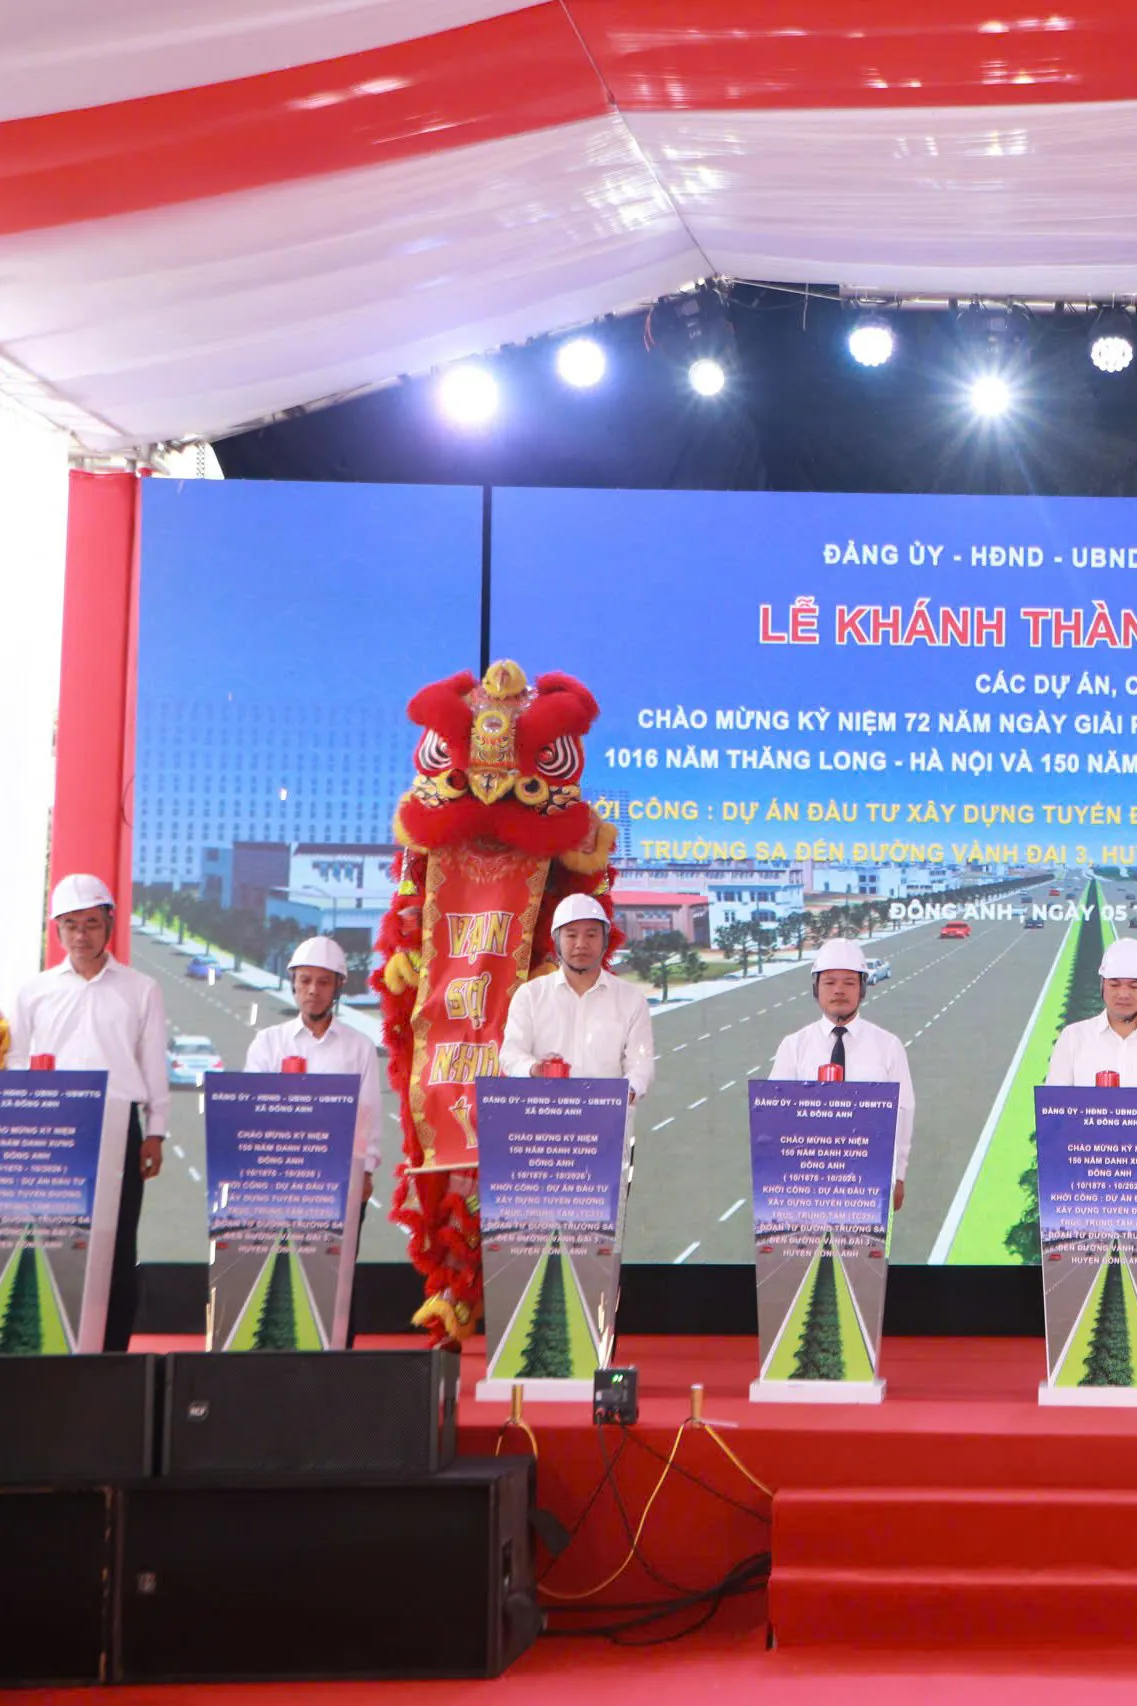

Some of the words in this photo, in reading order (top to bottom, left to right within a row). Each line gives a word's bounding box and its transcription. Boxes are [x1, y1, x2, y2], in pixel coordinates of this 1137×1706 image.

[823, 539, 899, 565] ĐẢNG
[909, 540, 944, 566] ỦY
[971, 545, 1044, 567] HĐND
[759, 595, 820, 645] LỄ
[835, 597, 1006, 647] KHÁNH
[975, 669, 1026, 694] CÁC
[1034, 674, 1071, 699] DỰ
[1076, 671, 1117, 697] ÁN,
[638, 705, 708, 729] CHÀO
[715, 706, 789, 730] MỪNG
[798, 707, 831, 731] KỶ
[838, 709, 897, 736] NIỆM
[904, 712, 930, 732] 72
[938, 709, 991, 733] NĂM
[999, 710, 1067, 734] NGÀY
[1074, 711, 1123, 734] GIẢI
[605, 748, 658, 768] 1016
[666, 745, 719, 769] NĂM
[726, 745, 811, 770] THĂNG
[819, 750, 887, 771] LONG
[910, 747, 944, 771] HÀ
[951, 750, 993, 776] NỘI
[1000, 748, 1033, 773] VÀ
[1041, 753, 1080, 773] 150
[628, 797, 698, 820] CÔNG
[722, 802, 759, 825] DỰ
[765, 798, 799, 821] ÁN
[866, 803, 901, 823] TƯ
[908, 800, 955, 823] XÂY
[963, 805, 1035, 827] DỰNG
[640, 837, 747, 861] TRƯỜNG
[755, 841, 787, 861] SA
[852, 839, 944, 863] ĐƯỜNG
[951, 840, 1018, 864] VÀNH
[1026, 845, 1067, 865] ĐAI
[1075, 846, 1093, 868] 3,
[889, 899, 956, 920] ĐÔNG
[963, 904, 1012, 920] ANH
[1032, 900, 1094, 921] NGÀY
[1100, 905, 1126, 921] 05
[447, 912, 514, 964] VẠN
[445, 972, 491, 1029] SỰ
